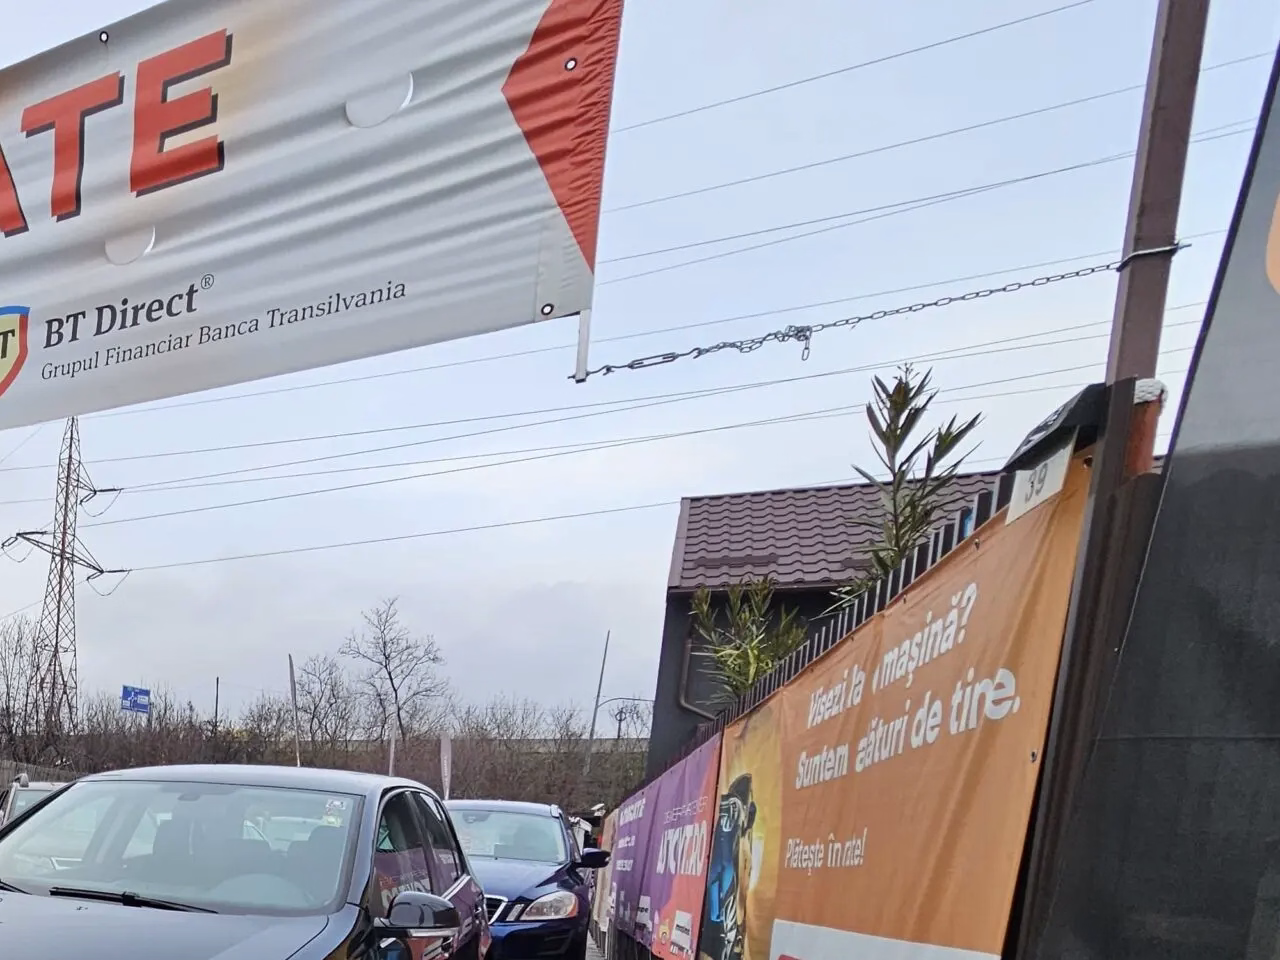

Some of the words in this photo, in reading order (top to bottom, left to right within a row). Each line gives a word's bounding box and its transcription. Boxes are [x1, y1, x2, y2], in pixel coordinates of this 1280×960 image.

[41, 350, 100, 381] Grupul
[104, 329, 193, 367] Financiar
[199, 316, 260, 346] Banca
[266, 279, 407, 336] Transilvania
[43, 310, 86, 349] BT
[847, 664, 866, 708] la
[880, 582, 977, 689] mașină?
[795, 744, 849, 790] Suntem
[911, 691, 942, 750] de
